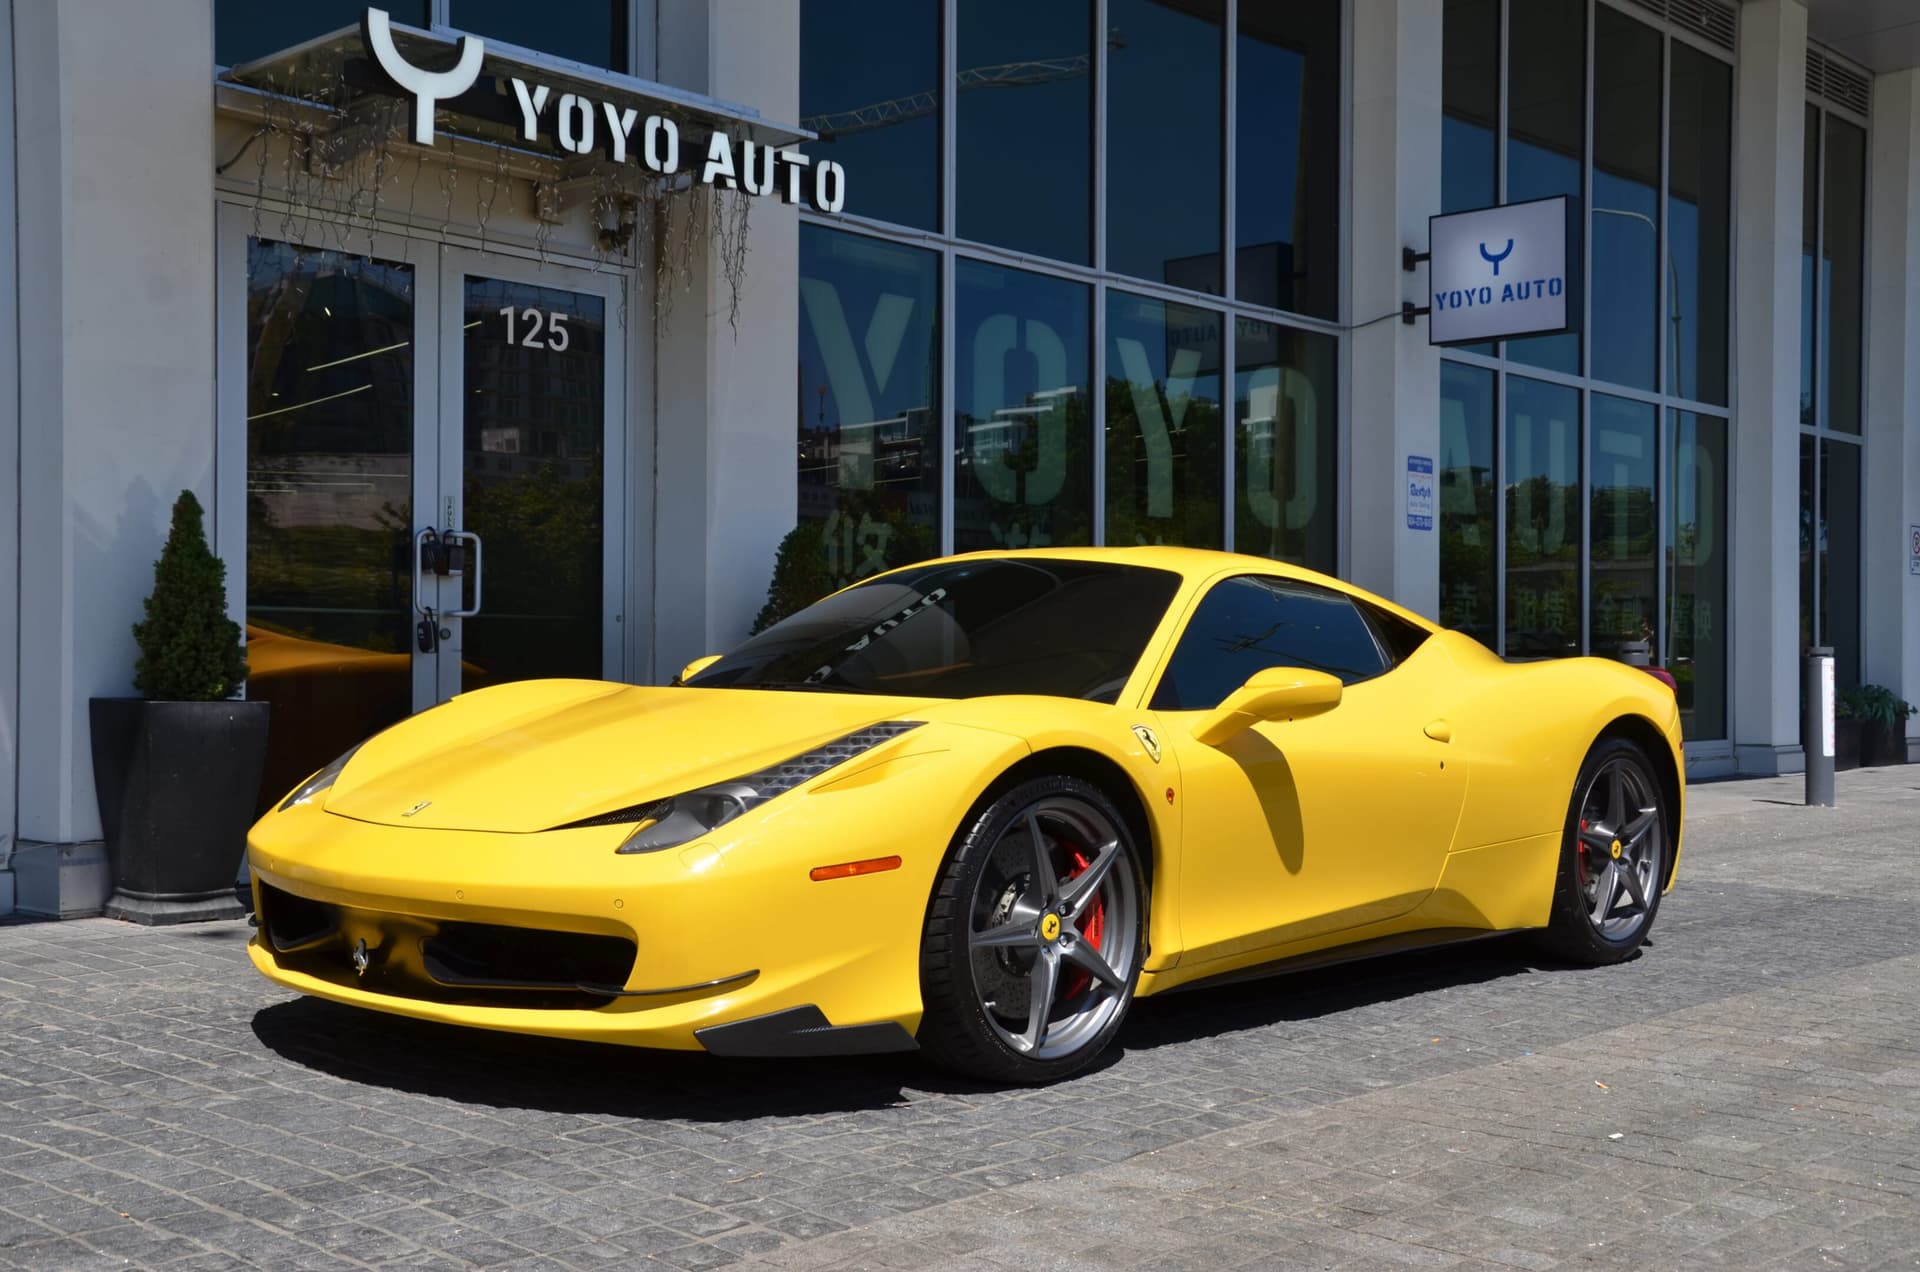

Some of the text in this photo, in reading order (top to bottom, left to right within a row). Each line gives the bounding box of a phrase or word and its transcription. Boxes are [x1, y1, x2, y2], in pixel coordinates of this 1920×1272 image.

[511, 77, 846, 214] YOYO AUTO
[500, 306, 569, 352] 125
[1435, 277, 1562, 311] YOYO AUTO
[799, 277, 1318, 530] YOYO
